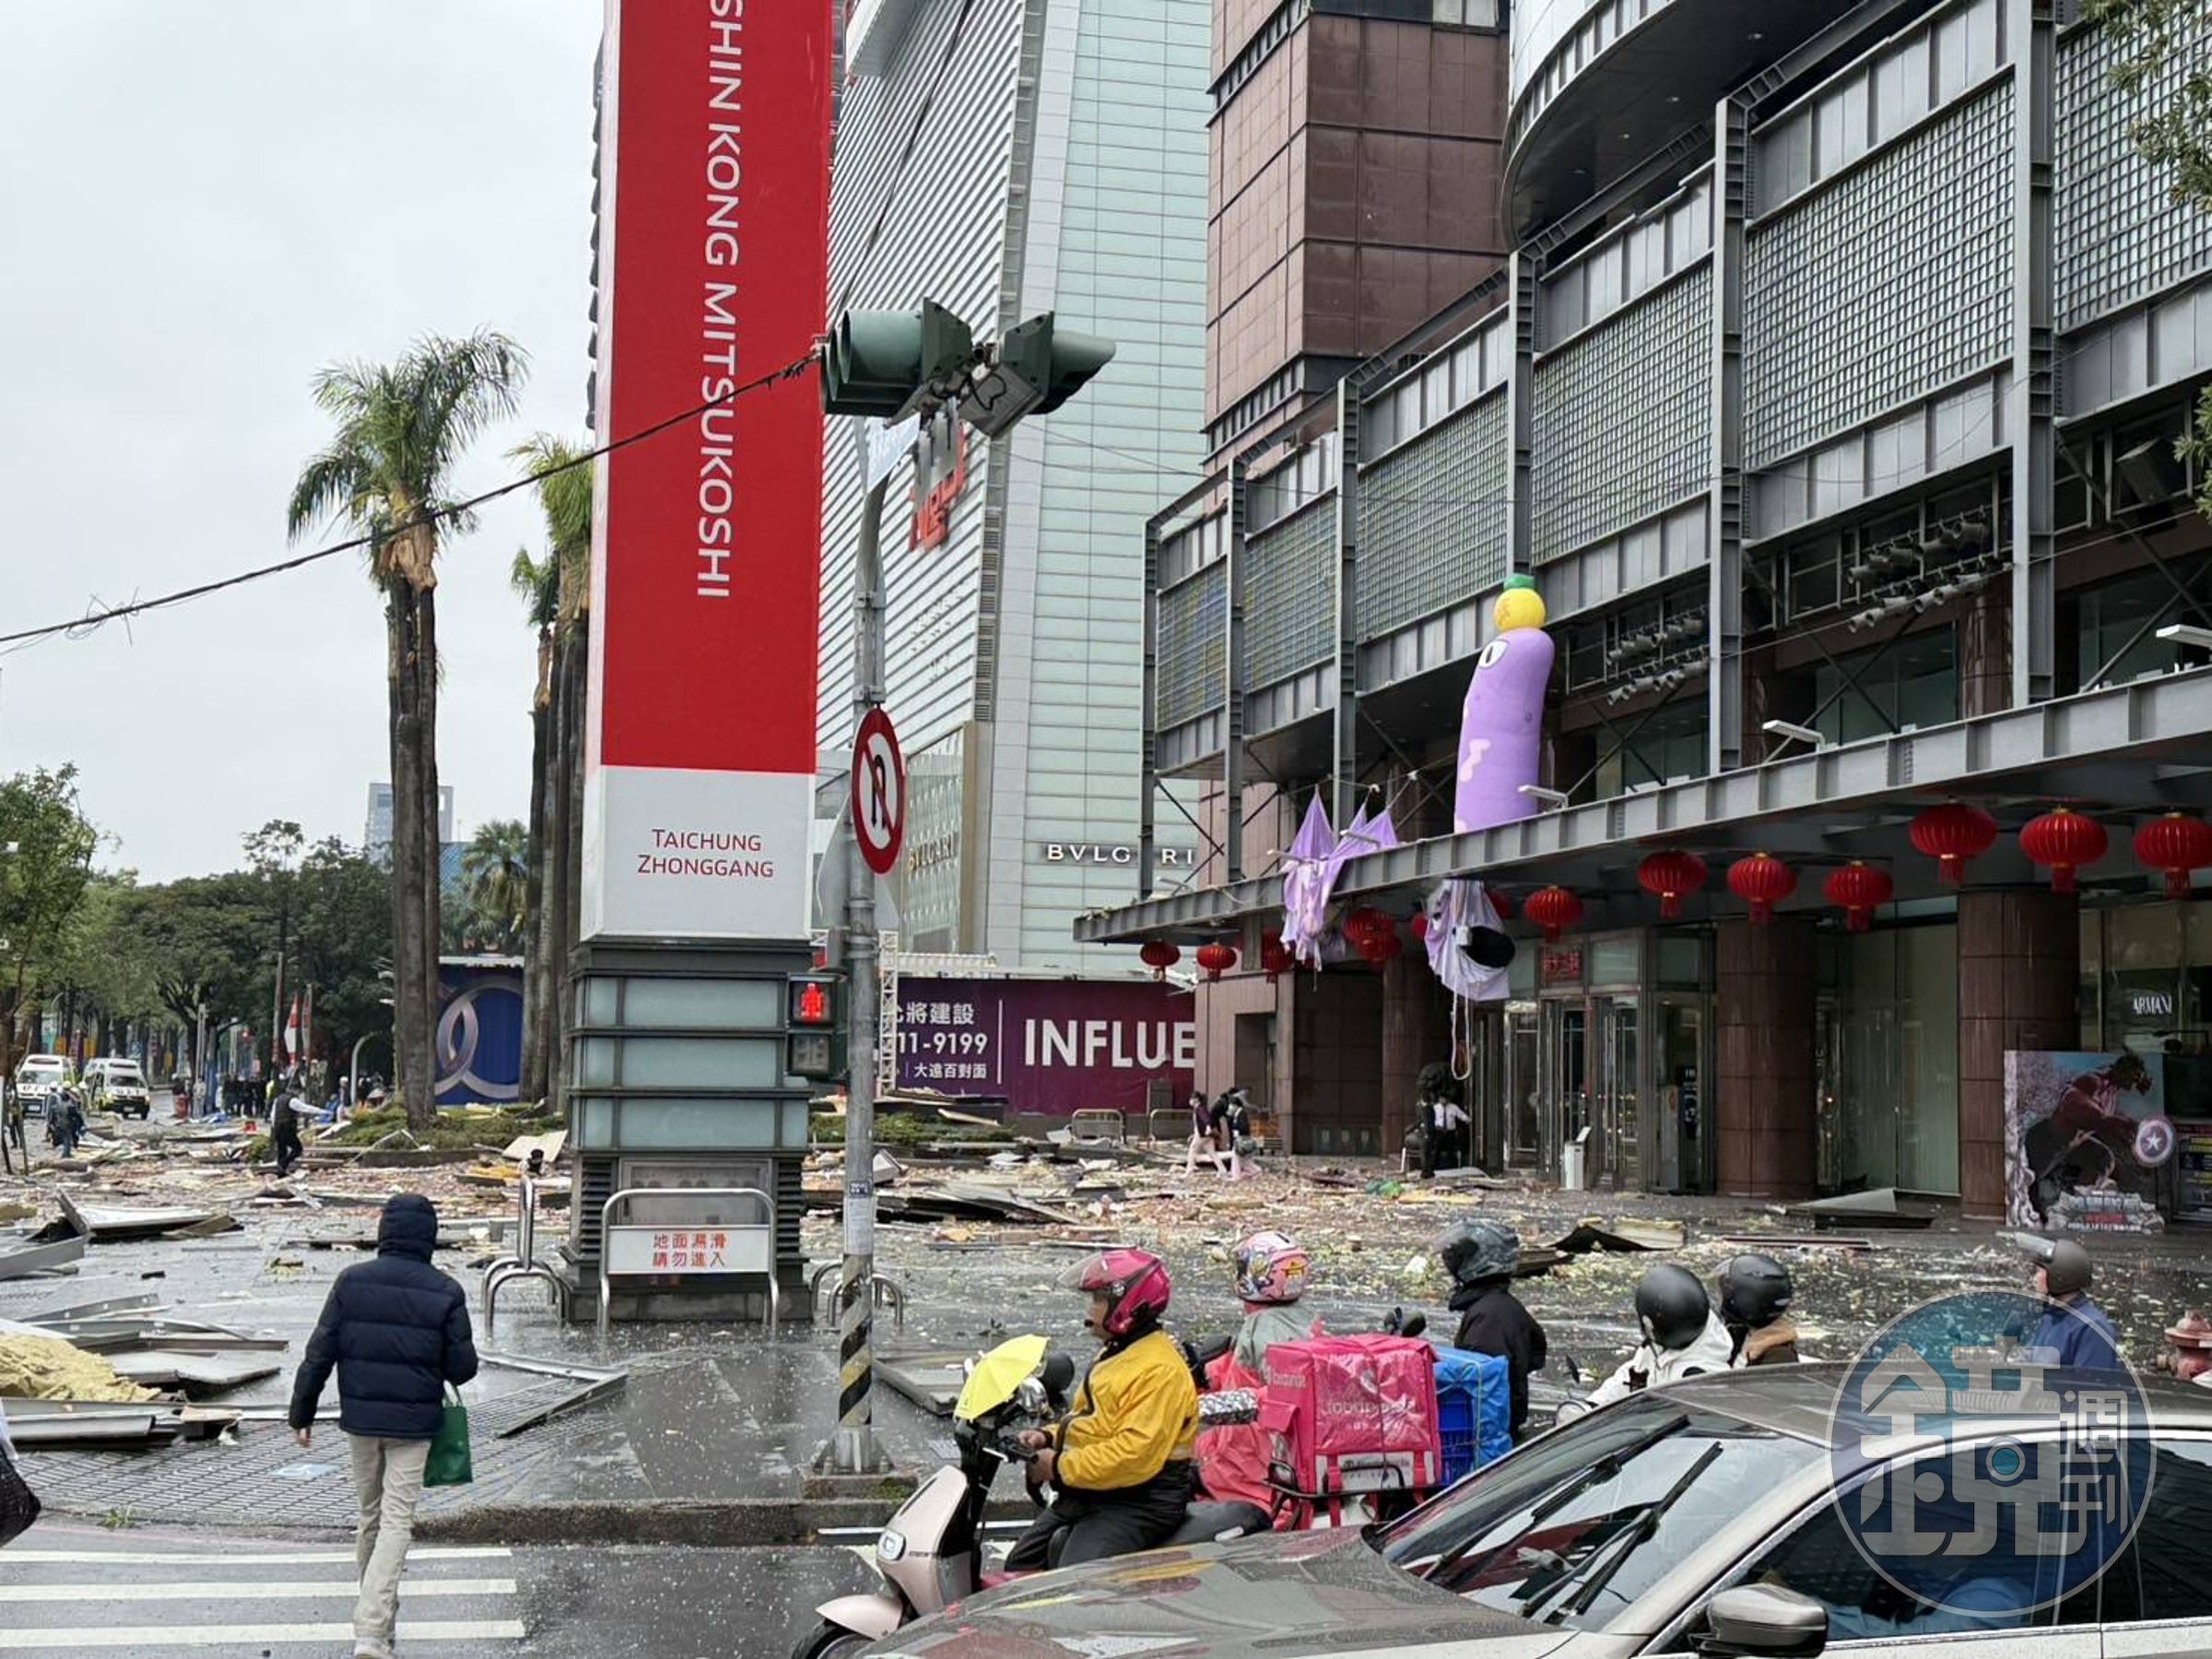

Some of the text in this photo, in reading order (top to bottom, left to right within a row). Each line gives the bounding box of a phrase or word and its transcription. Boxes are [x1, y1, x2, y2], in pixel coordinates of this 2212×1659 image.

[698, 0, 743, 597] SHIN KONG MITSUKOSHI
[652, 829, 761, 852] TAICHUNG
[637, 854, 774, 877] ZHONGGANG
[1047, 843, 1194, 865] BVLGRI
[1025, 1018, 1195, 1069] INFLUE
[653, 1252, 725, 1268] 請勿進入
